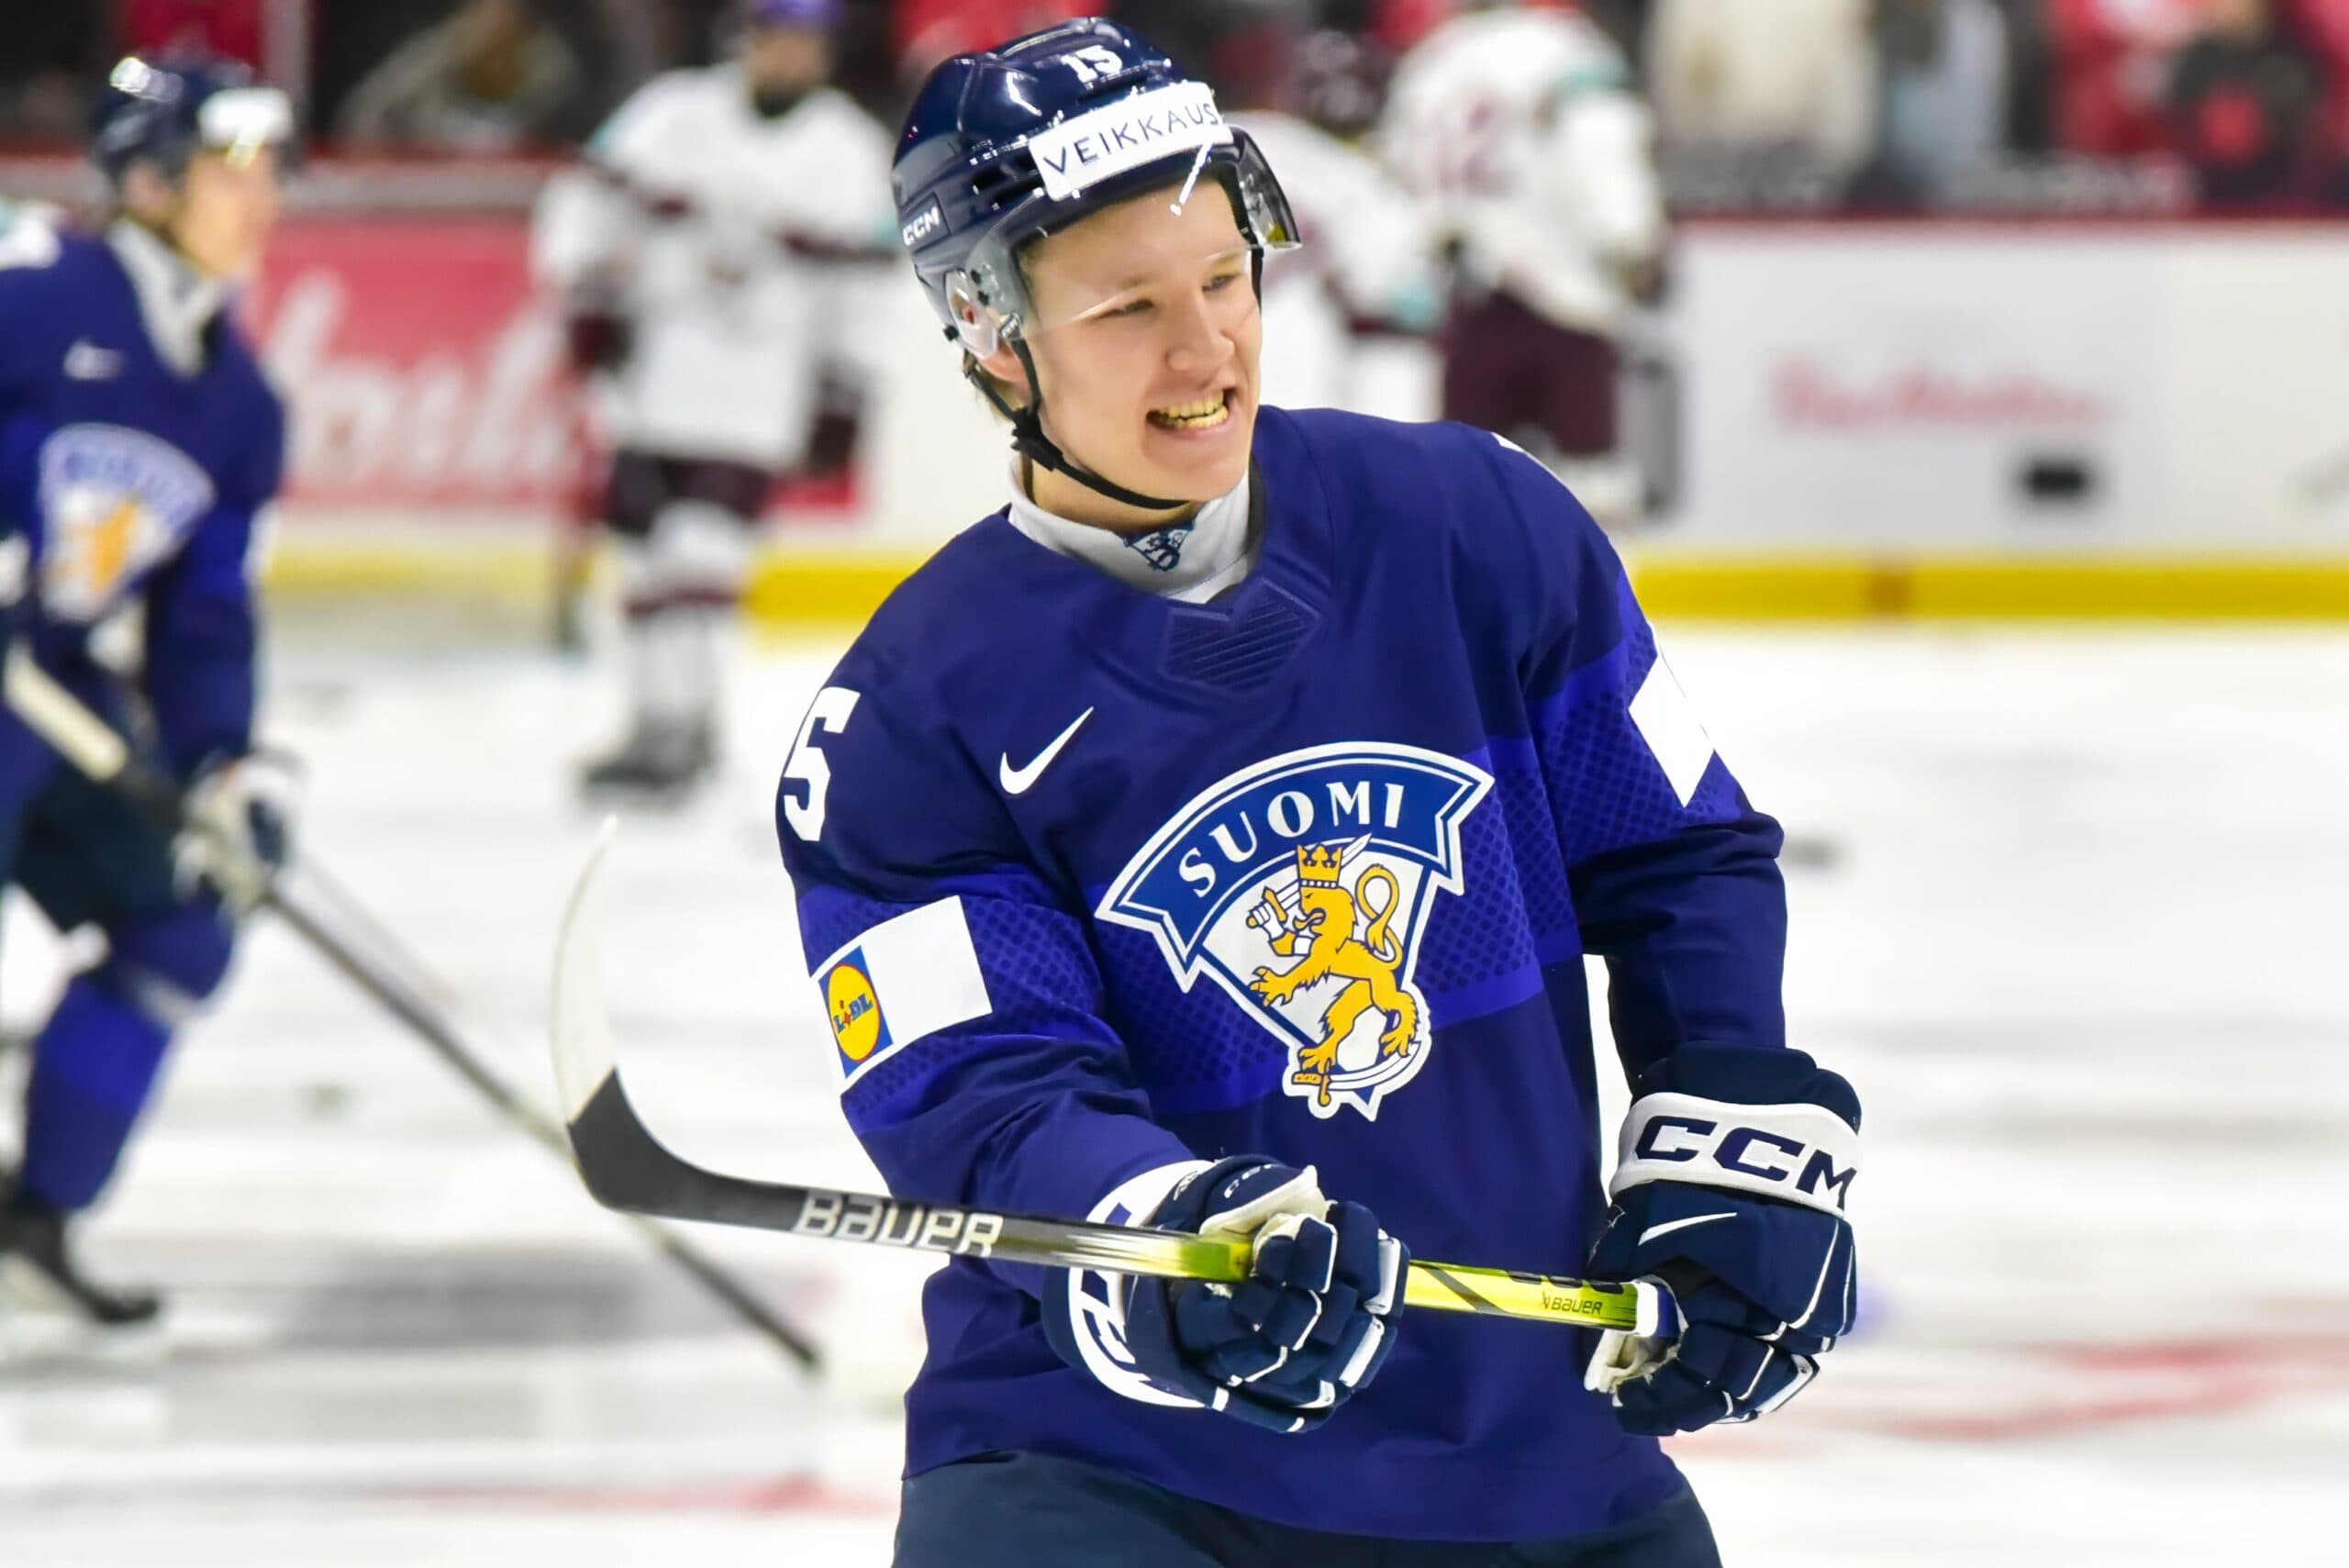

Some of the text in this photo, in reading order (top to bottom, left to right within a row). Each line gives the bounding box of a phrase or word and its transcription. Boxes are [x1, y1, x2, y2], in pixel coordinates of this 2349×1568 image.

[1061, 45, 1122, 83] 15
[1042, 103, 1219, 175] VEIKKAUS
[902, 206, 940, 246] CCM
[1179, 781, 1404, 897] SUOMI
[1634, 1115, 1857, 1209] CCM
